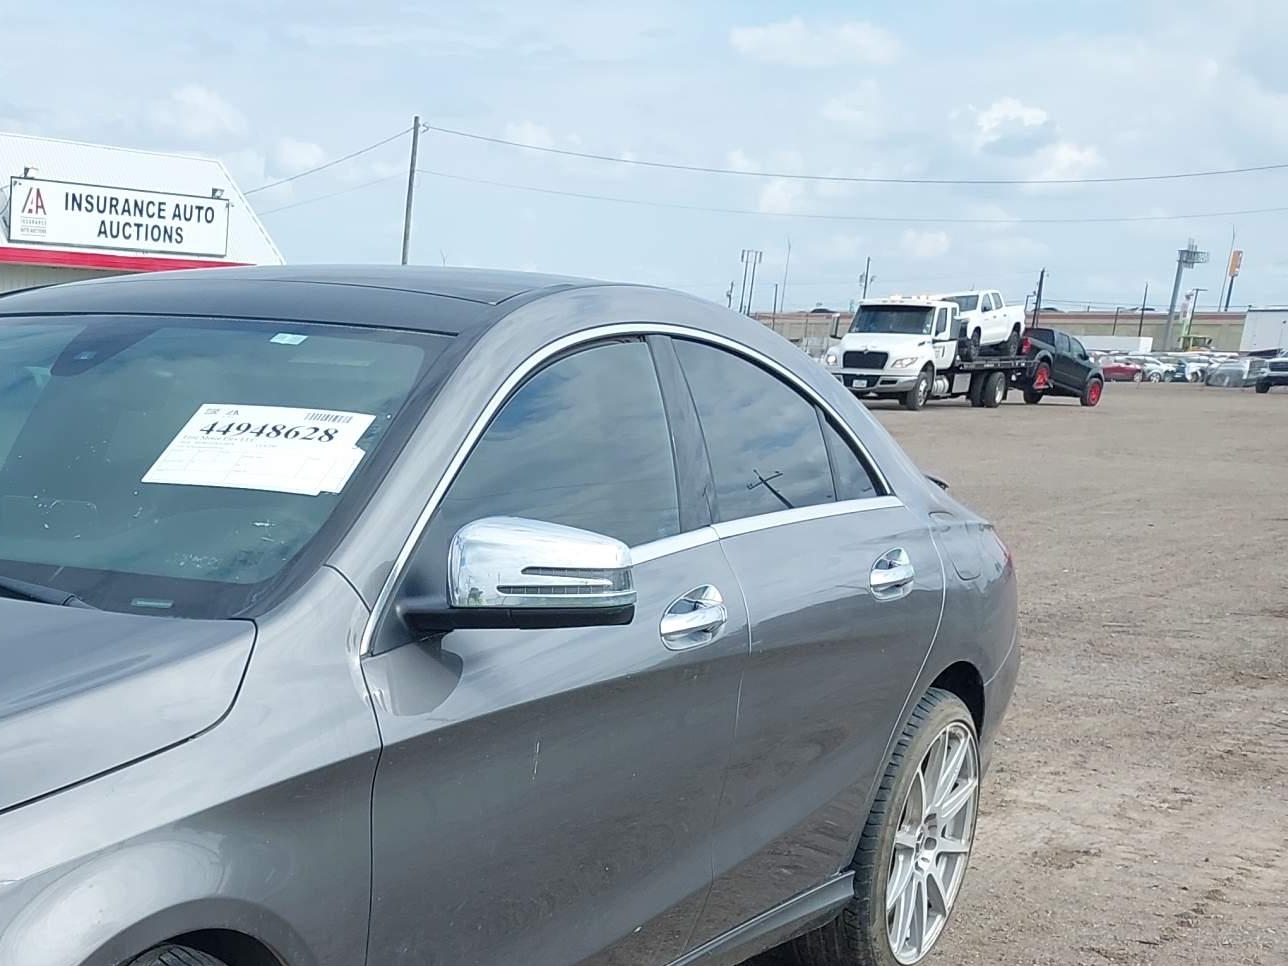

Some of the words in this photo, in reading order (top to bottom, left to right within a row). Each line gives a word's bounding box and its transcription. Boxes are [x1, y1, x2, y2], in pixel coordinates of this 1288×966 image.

[64, 191, 167, 220] INSURANCE
[172, 203, 215, 224] AUTO
[97, 220, 184, 244] AUCTIONS
[199, 420, 339, 443] 44948628
